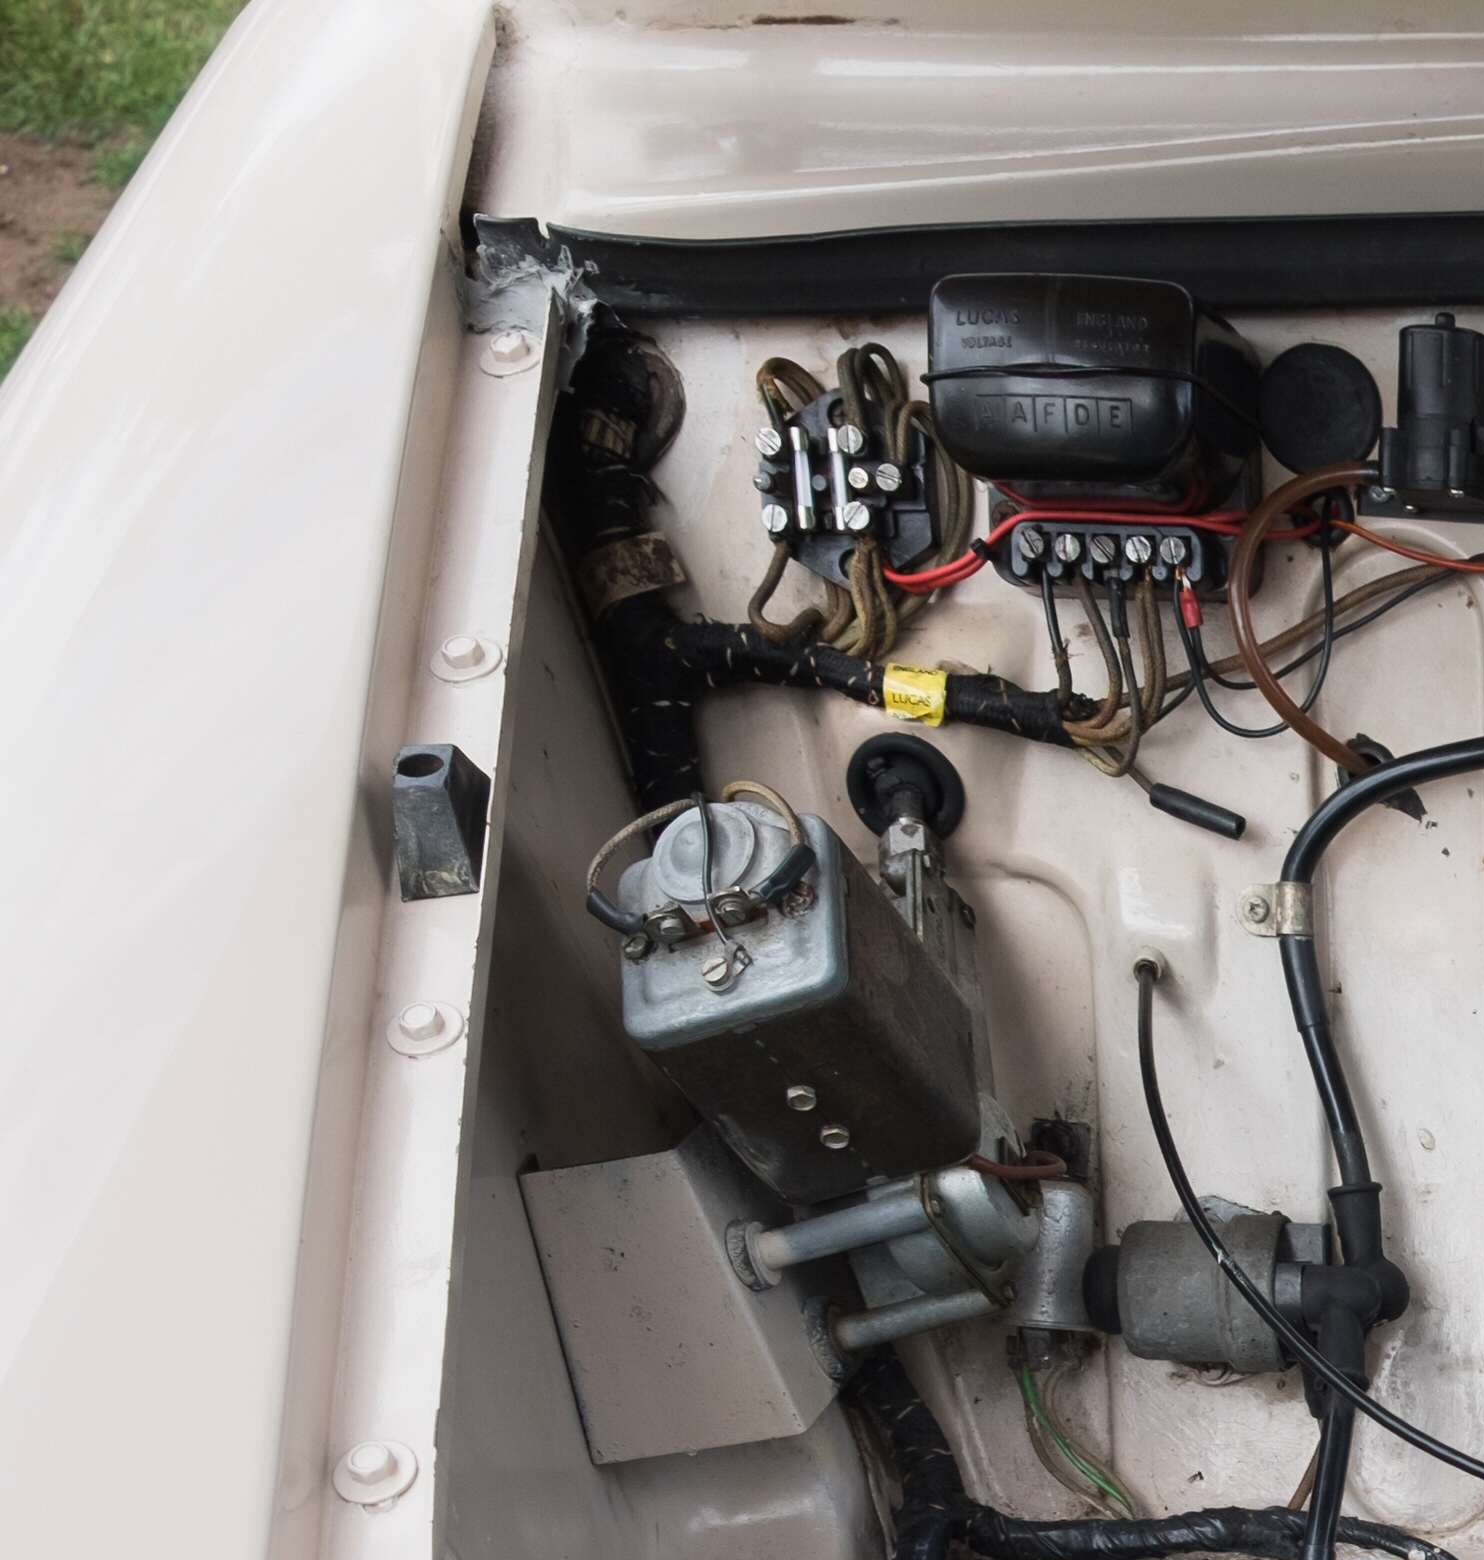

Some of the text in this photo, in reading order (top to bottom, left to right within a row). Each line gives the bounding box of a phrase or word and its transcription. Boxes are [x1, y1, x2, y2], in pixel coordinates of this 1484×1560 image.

[956, 308, 1149, 330] LUCAS ENGLAND
[1012, 401, 1027, 424] A
[1044, 402, 1056, 424] F
[1075, 403, 1090, 426] D
[1110, 405, 1121, 428] E
[892, 692, 932, 708] LUCAS
